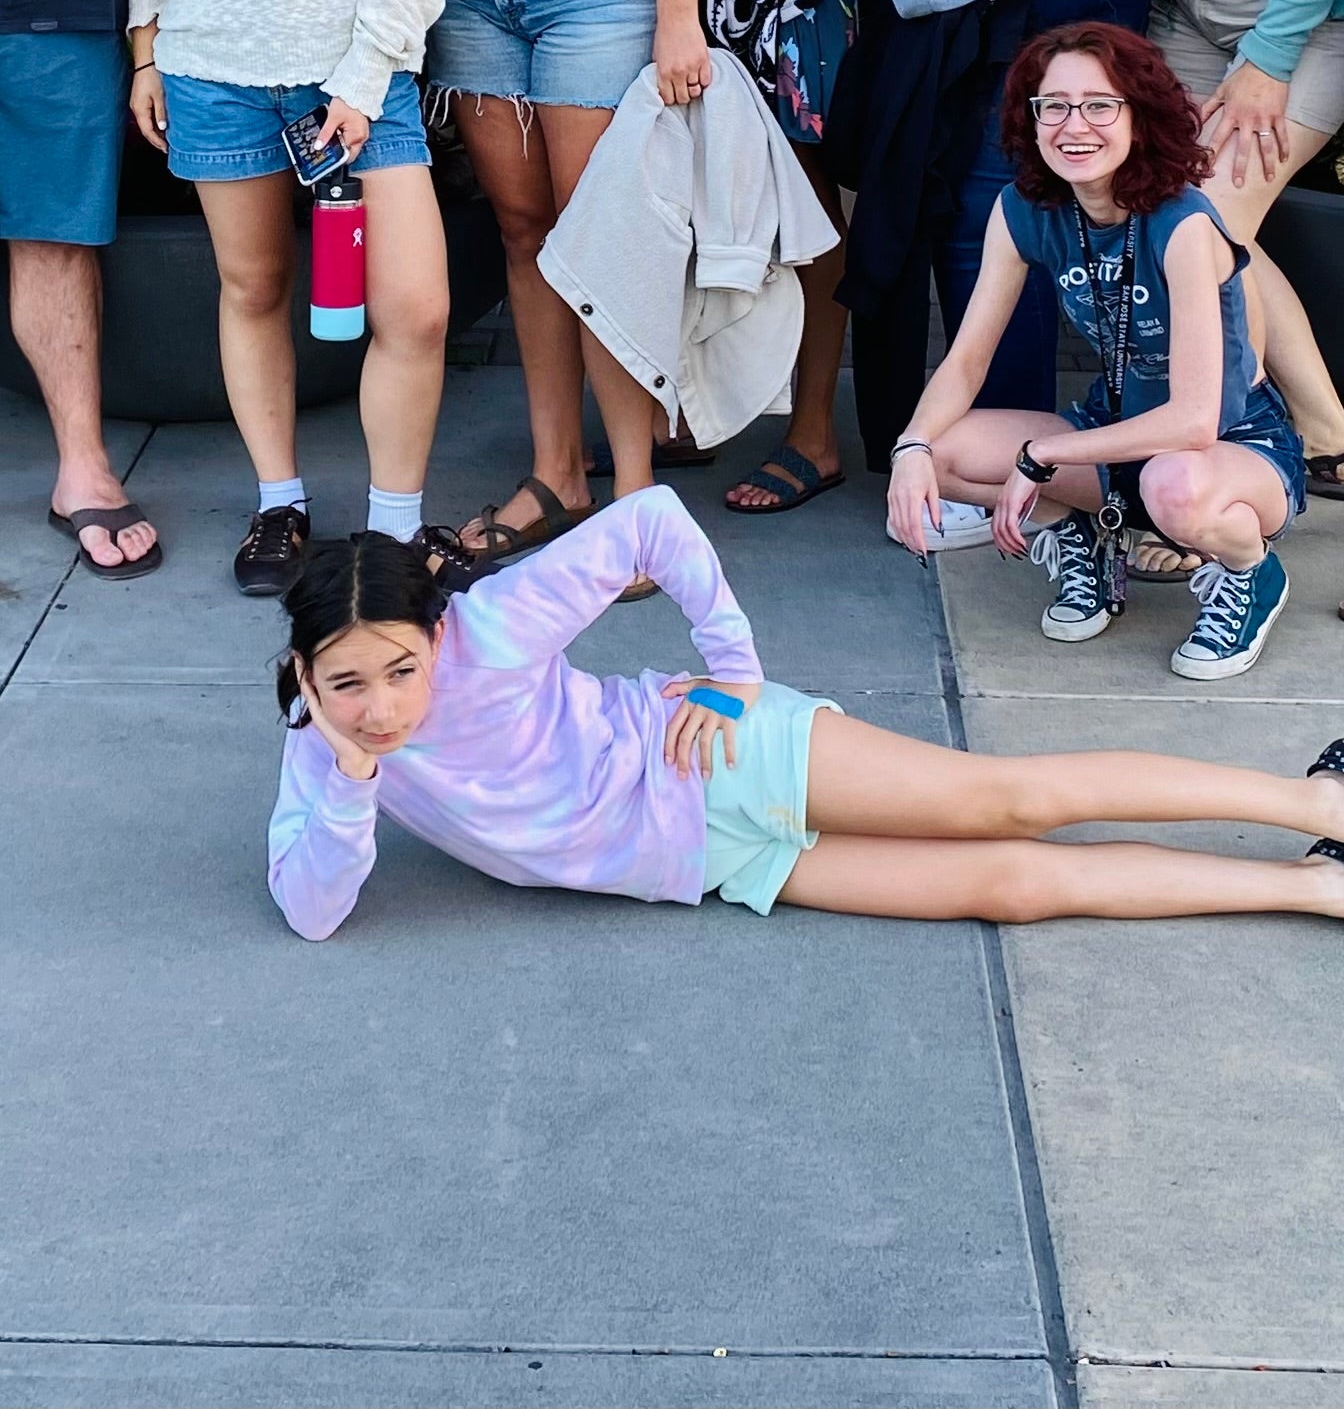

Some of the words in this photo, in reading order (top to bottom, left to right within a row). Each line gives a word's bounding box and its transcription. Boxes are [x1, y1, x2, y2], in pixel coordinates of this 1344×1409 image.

[1122, 284, 1131, 302] SAN
[1119, 303, 1129, 322] JOSE
[1117, 323, 1127, 348] STATE
[1114, 349, 1126, 395] UNIVERSITY
